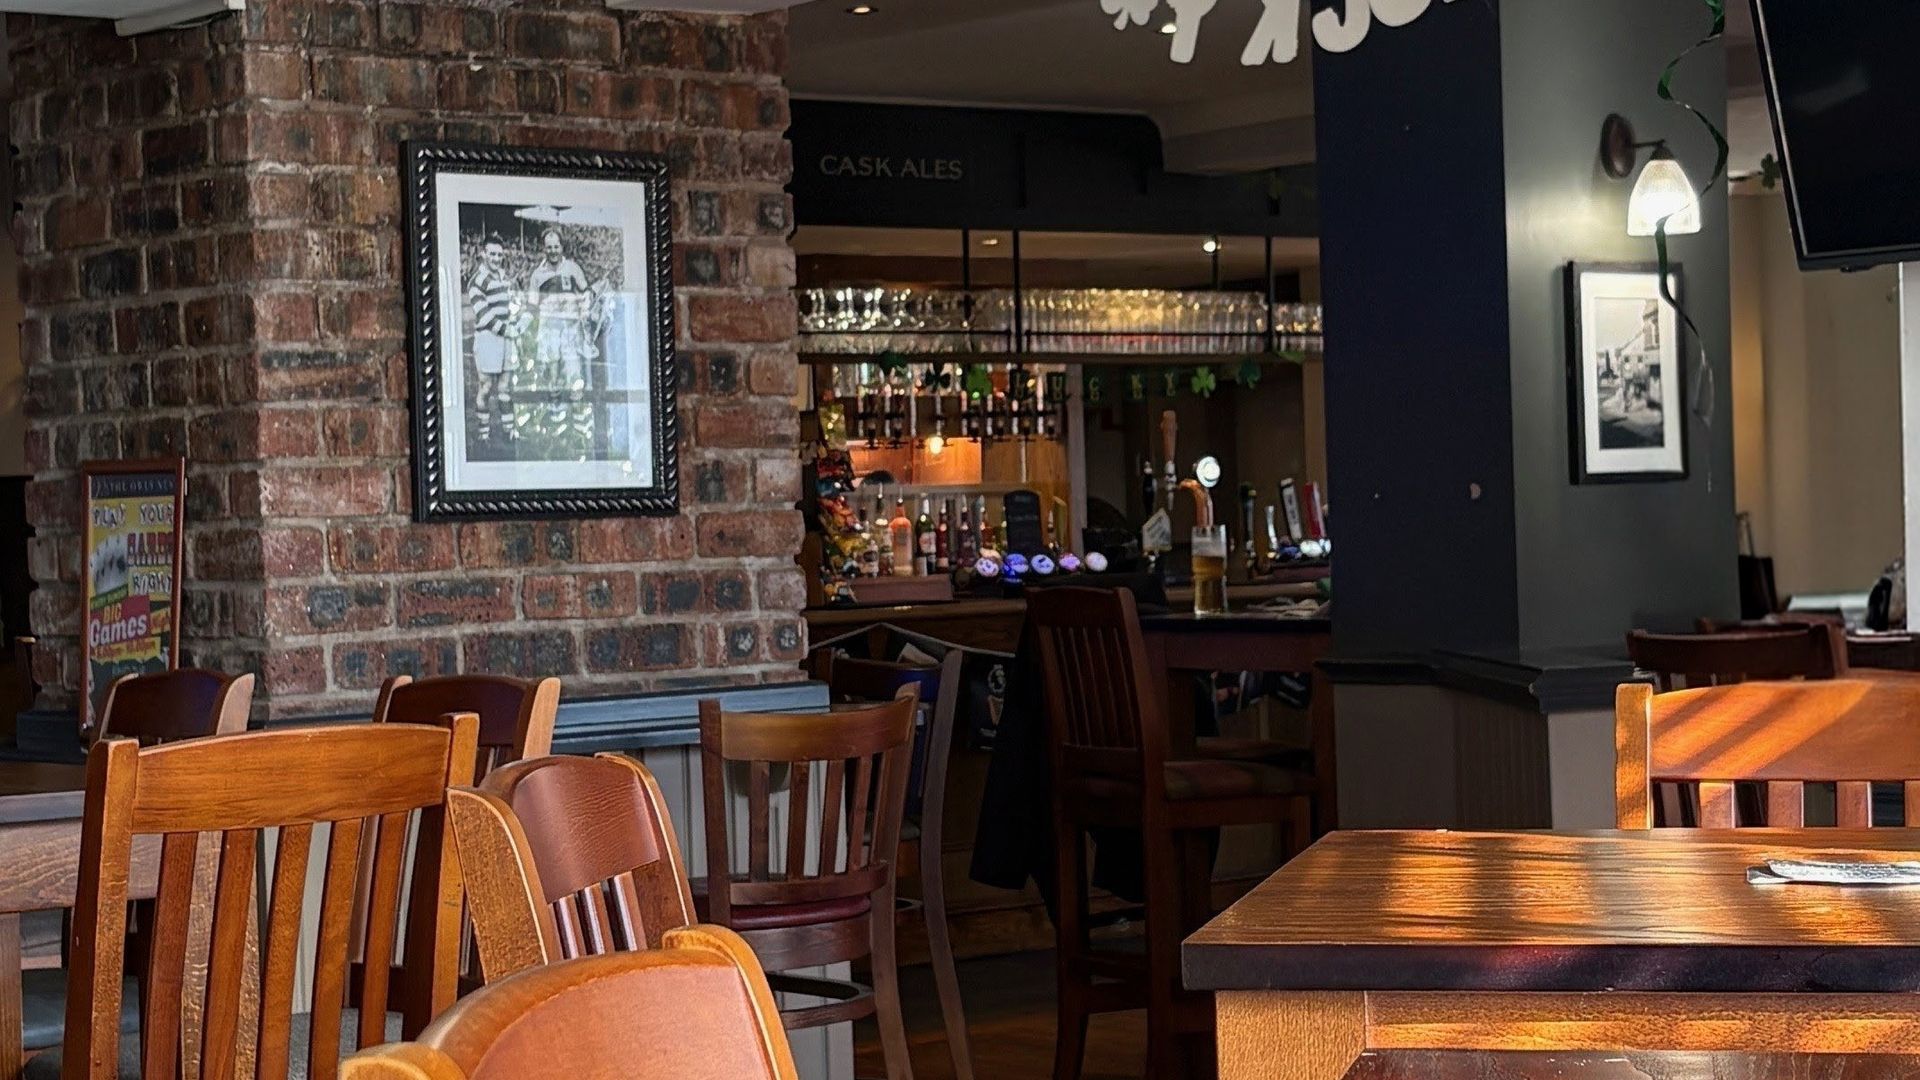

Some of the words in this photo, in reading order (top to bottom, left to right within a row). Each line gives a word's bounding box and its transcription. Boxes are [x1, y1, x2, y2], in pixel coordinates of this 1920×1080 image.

[820, 154, 893, 178] CASK
[901, 158, 963, 181] ALES
[104, 603, 122, 624] BIG
[90, 614, 148, 647] Games
